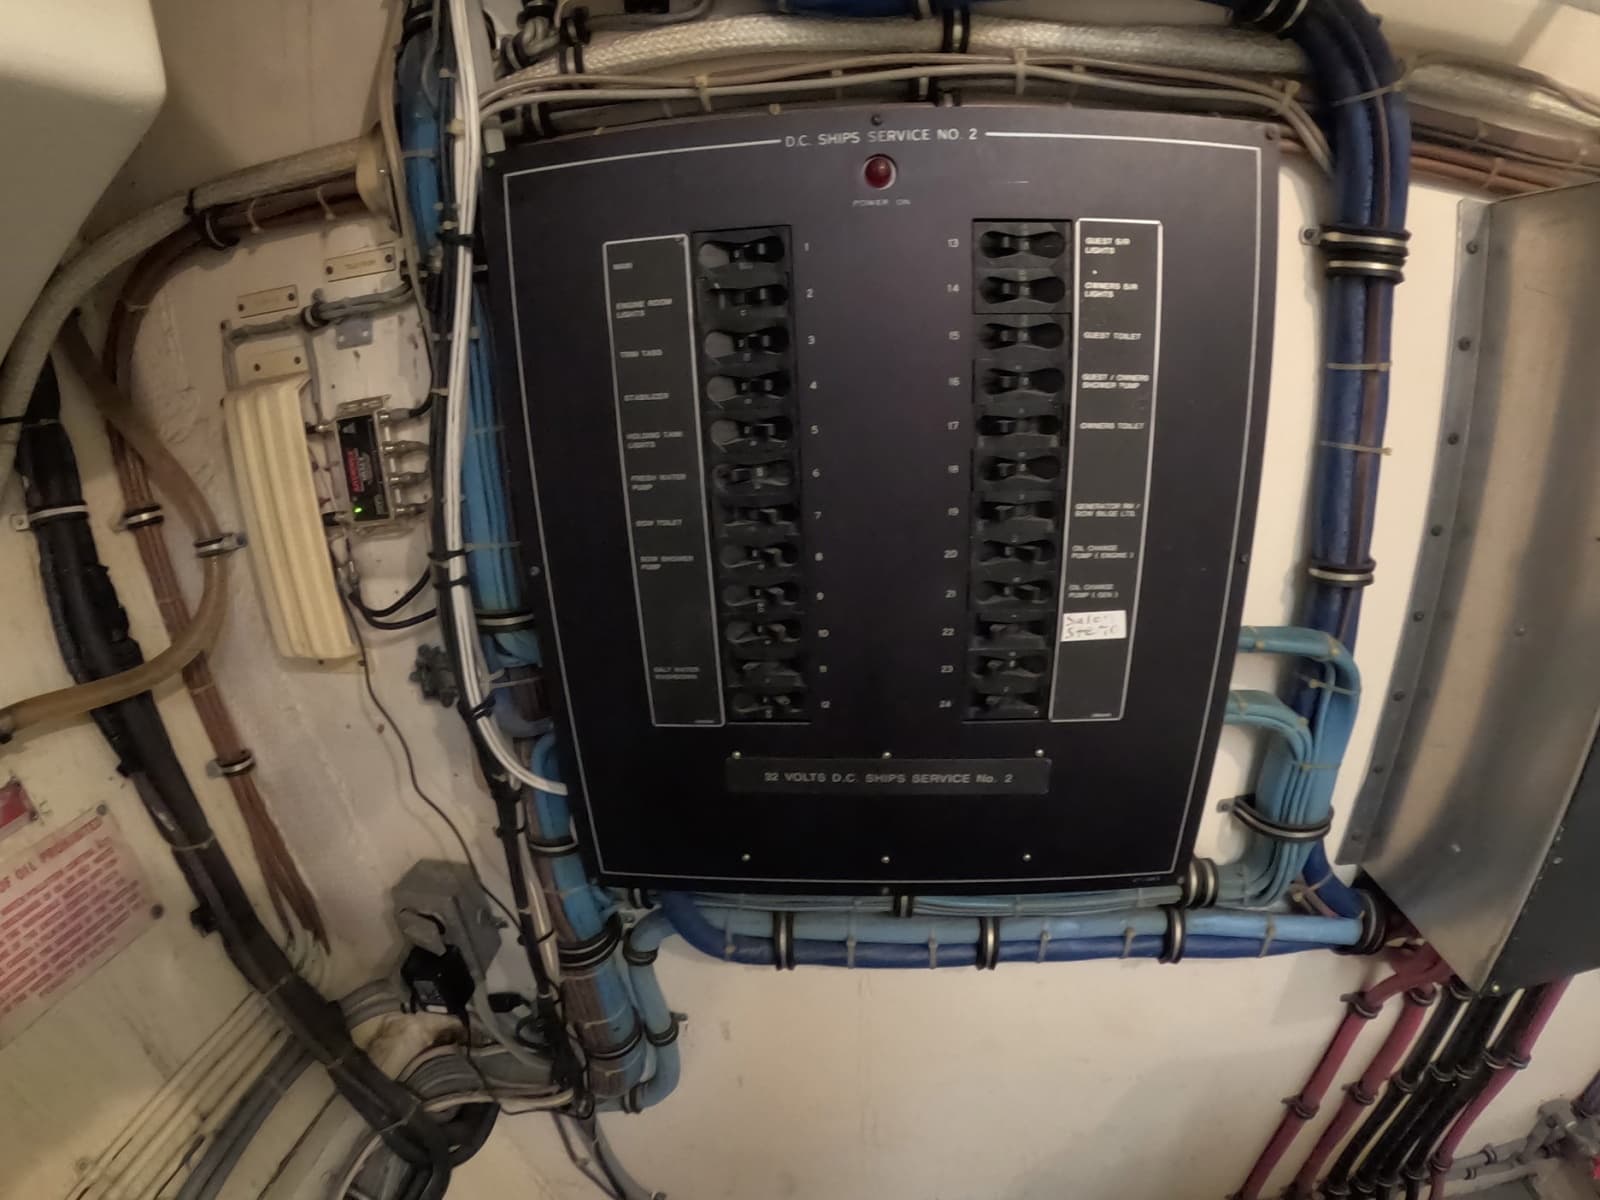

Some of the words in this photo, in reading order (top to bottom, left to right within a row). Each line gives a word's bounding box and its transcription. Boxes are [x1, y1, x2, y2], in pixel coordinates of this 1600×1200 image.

[818, 132, 860, 145] SHIPS
[868, 129, 930, 143] SERVICE
[968, 128, 978, 140] 2
[852, 199, 889, 207] POWER
[948, 238, 960, 248] 13
[806, 288, 814, 298] 2
[947, 284, 960, 293] 14
[808, 335, 816, 345] 3
[949, 331, 960, 340] 15
[809, 381, 817, 390] 4
[948, 377, 960, 387] 16
[811, 425, 819, 435] 5
[948, 421, 960, 431] 17
[812, 467, 820, 478] 6
[814, 511, 822, 520] 7
[944, 549, 959, 559] 20
[816, 591, 824, 601] 9
[945, 590, 957, 599] 21
[942, 627, 955, 637] 22
[784, 772, 827, 783] VOLTS
[865, 773, 906, 784] SHIPS
[911, 773, 971, 784] SERVICE
[1004, 773, 1013, 784] 2
